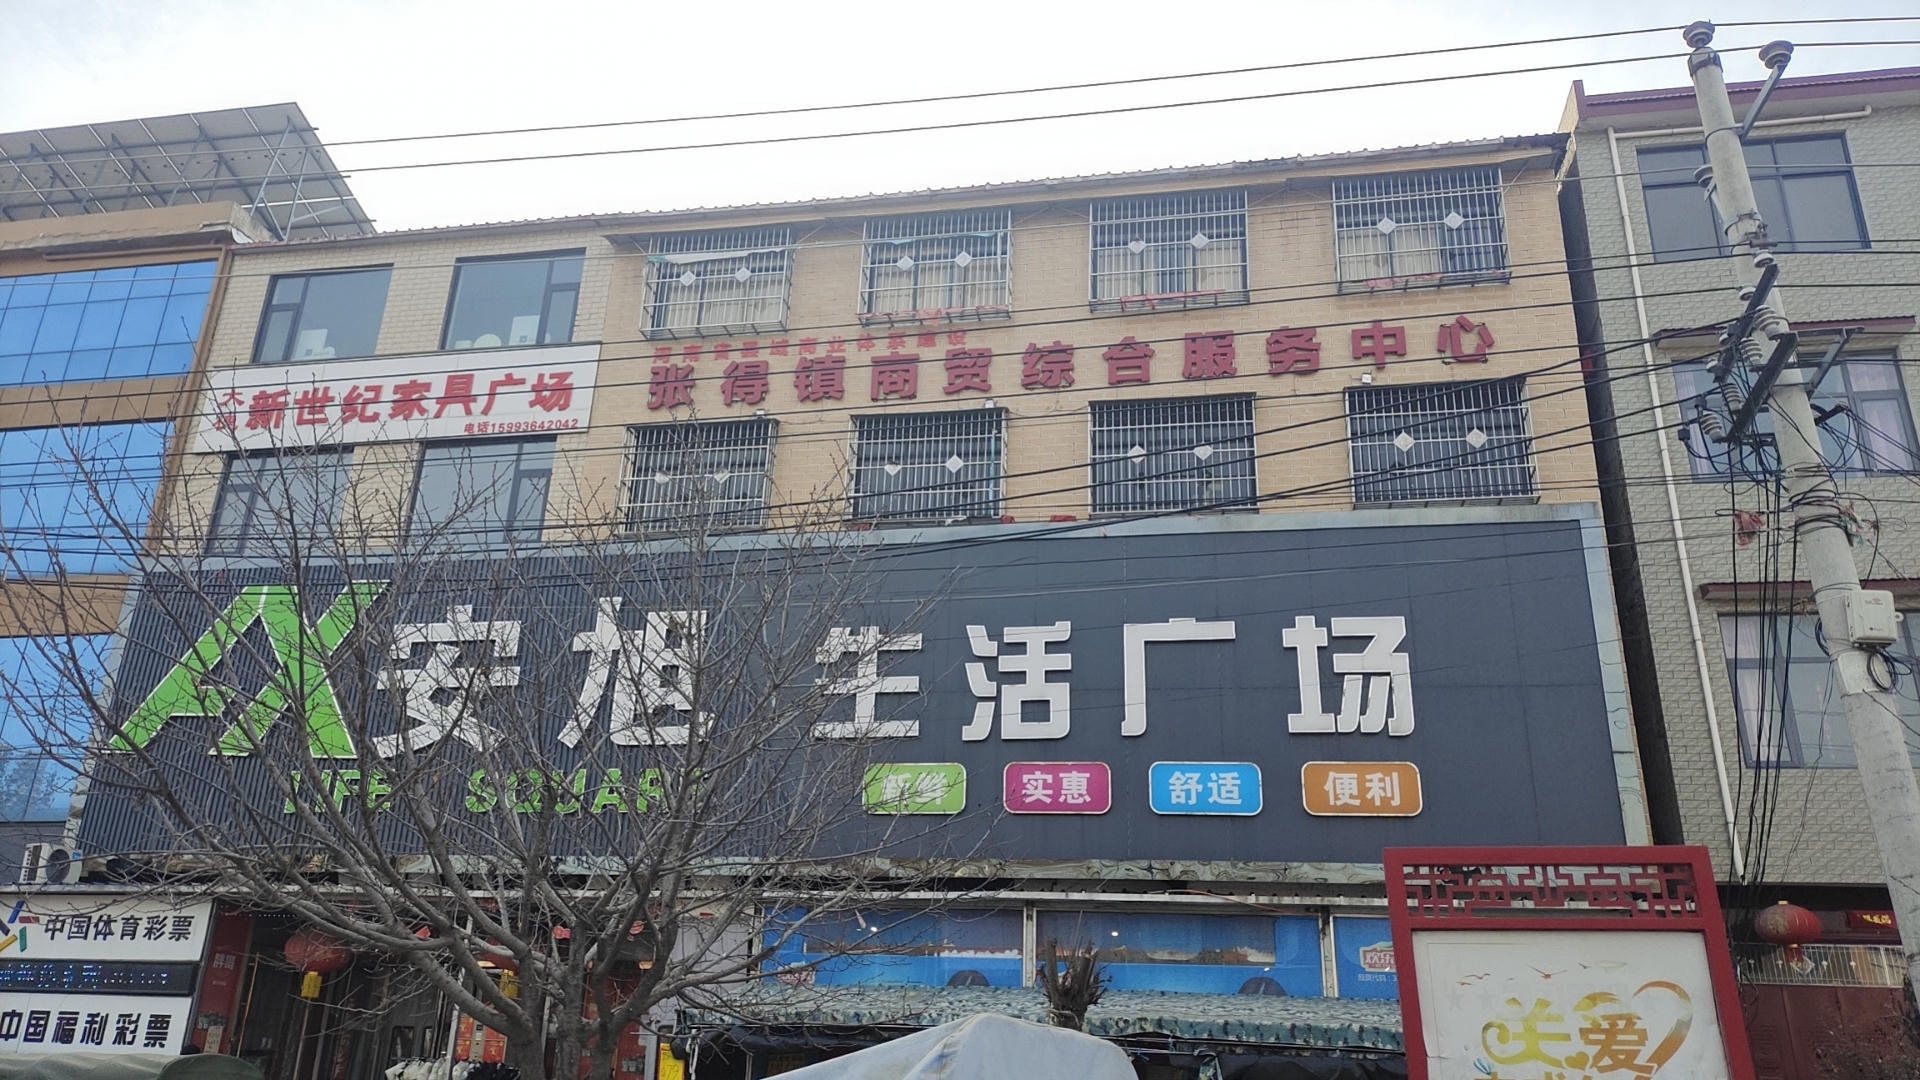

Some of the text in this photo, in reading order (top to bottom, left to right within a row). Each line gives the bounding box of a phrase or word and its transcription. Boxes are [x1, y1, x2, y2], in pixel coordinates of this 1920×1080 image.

[647, 314, 1495, 410] 张得镇商贸综合服务中心
[245, 371, 575, 430] 新世纪家具广场
[1021, 769, 1091, 805] 实惠
[1168, 769, 1243, 806] 舒适
[1324, 769, 1401, 807] 便利
[44, 914, 194, 942] 中国体育彩票
[0, 1009, 172, 1048] 中国福利彩票
[1481, 991, 1660, 1074] 关爱
